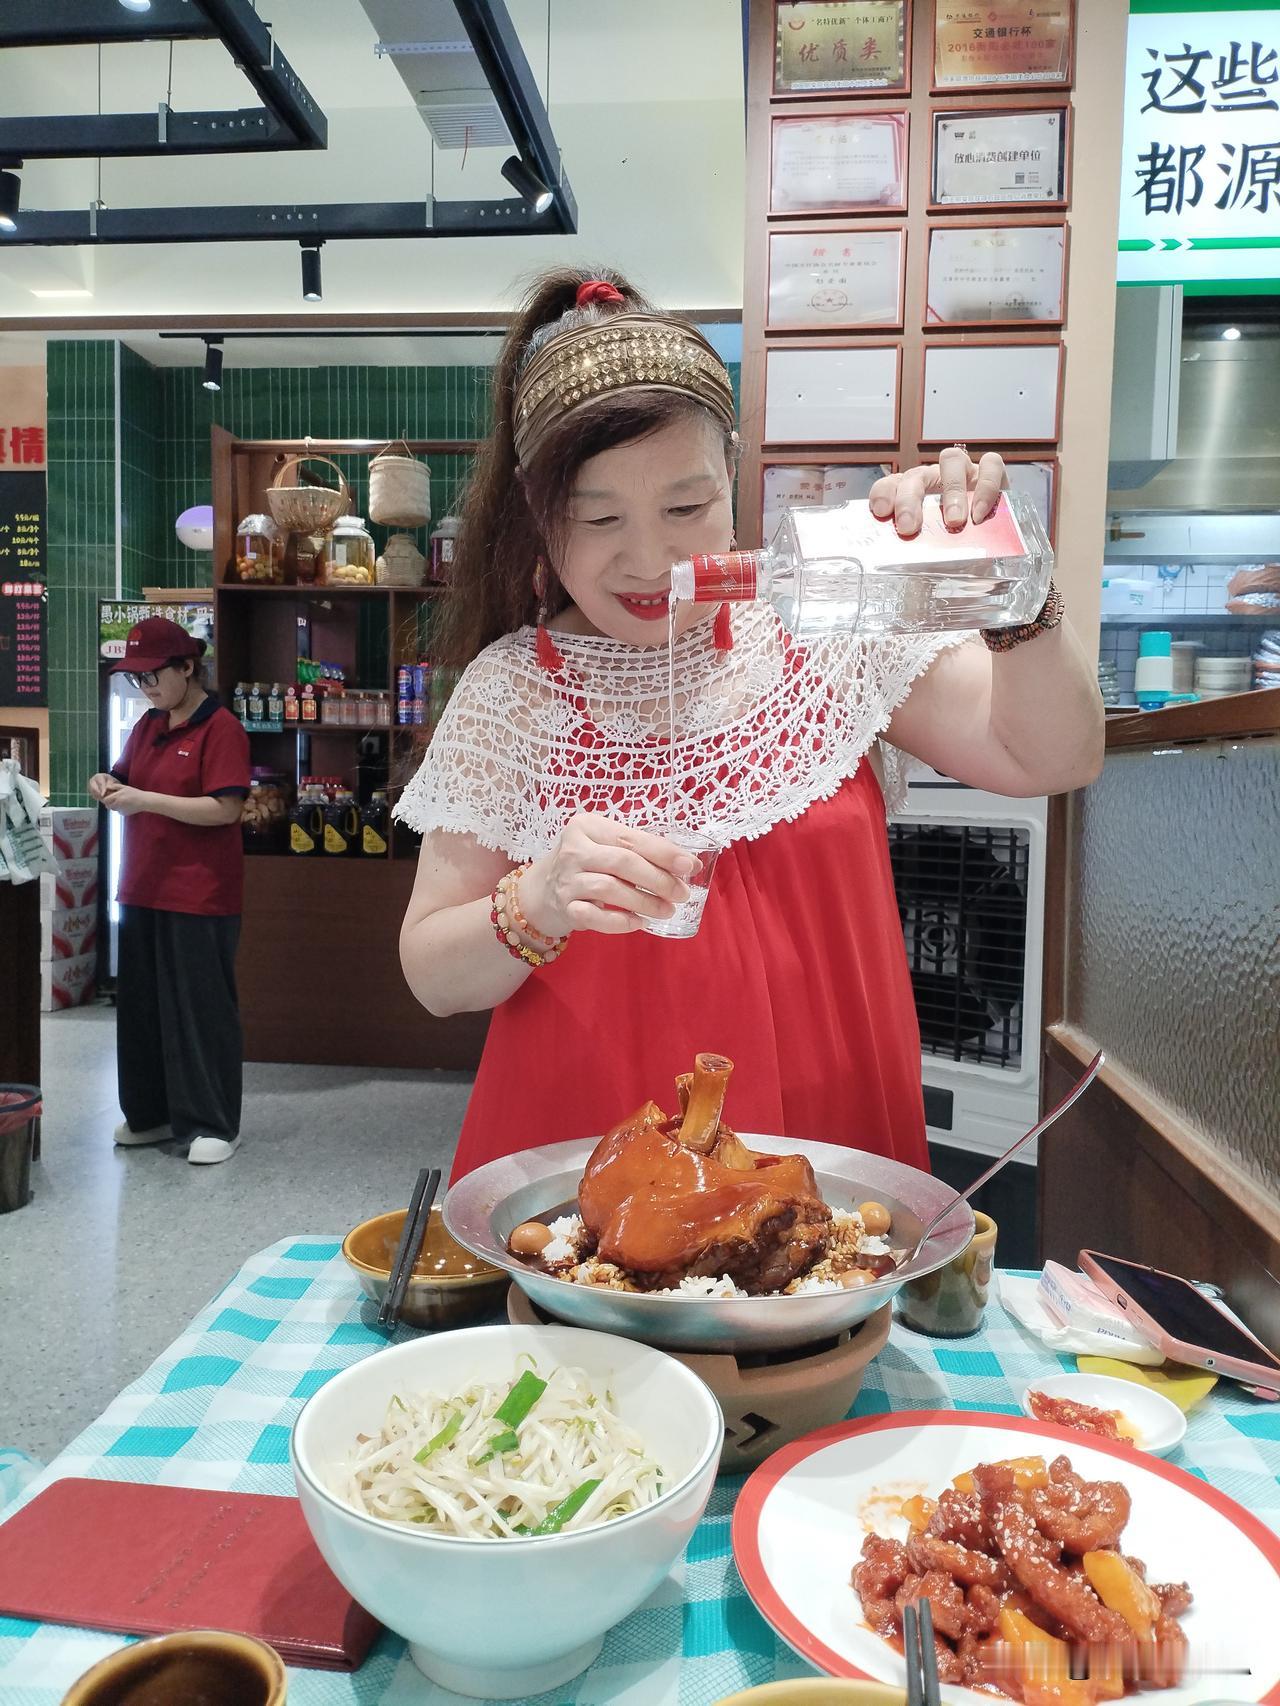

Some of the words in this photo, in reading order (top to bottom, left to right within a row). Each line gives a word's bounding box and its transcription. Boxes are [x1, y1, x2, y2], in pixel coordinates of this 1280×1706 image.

[972, 26, 1033, 39] 交通银行杯
[798, 36, 882, 63] 优质类
[1140, 41, 1280, 115] 这些
[953, 149, 1042, 165] 放心消费创建单位
[1131, 141, 1280, 216] 都源
